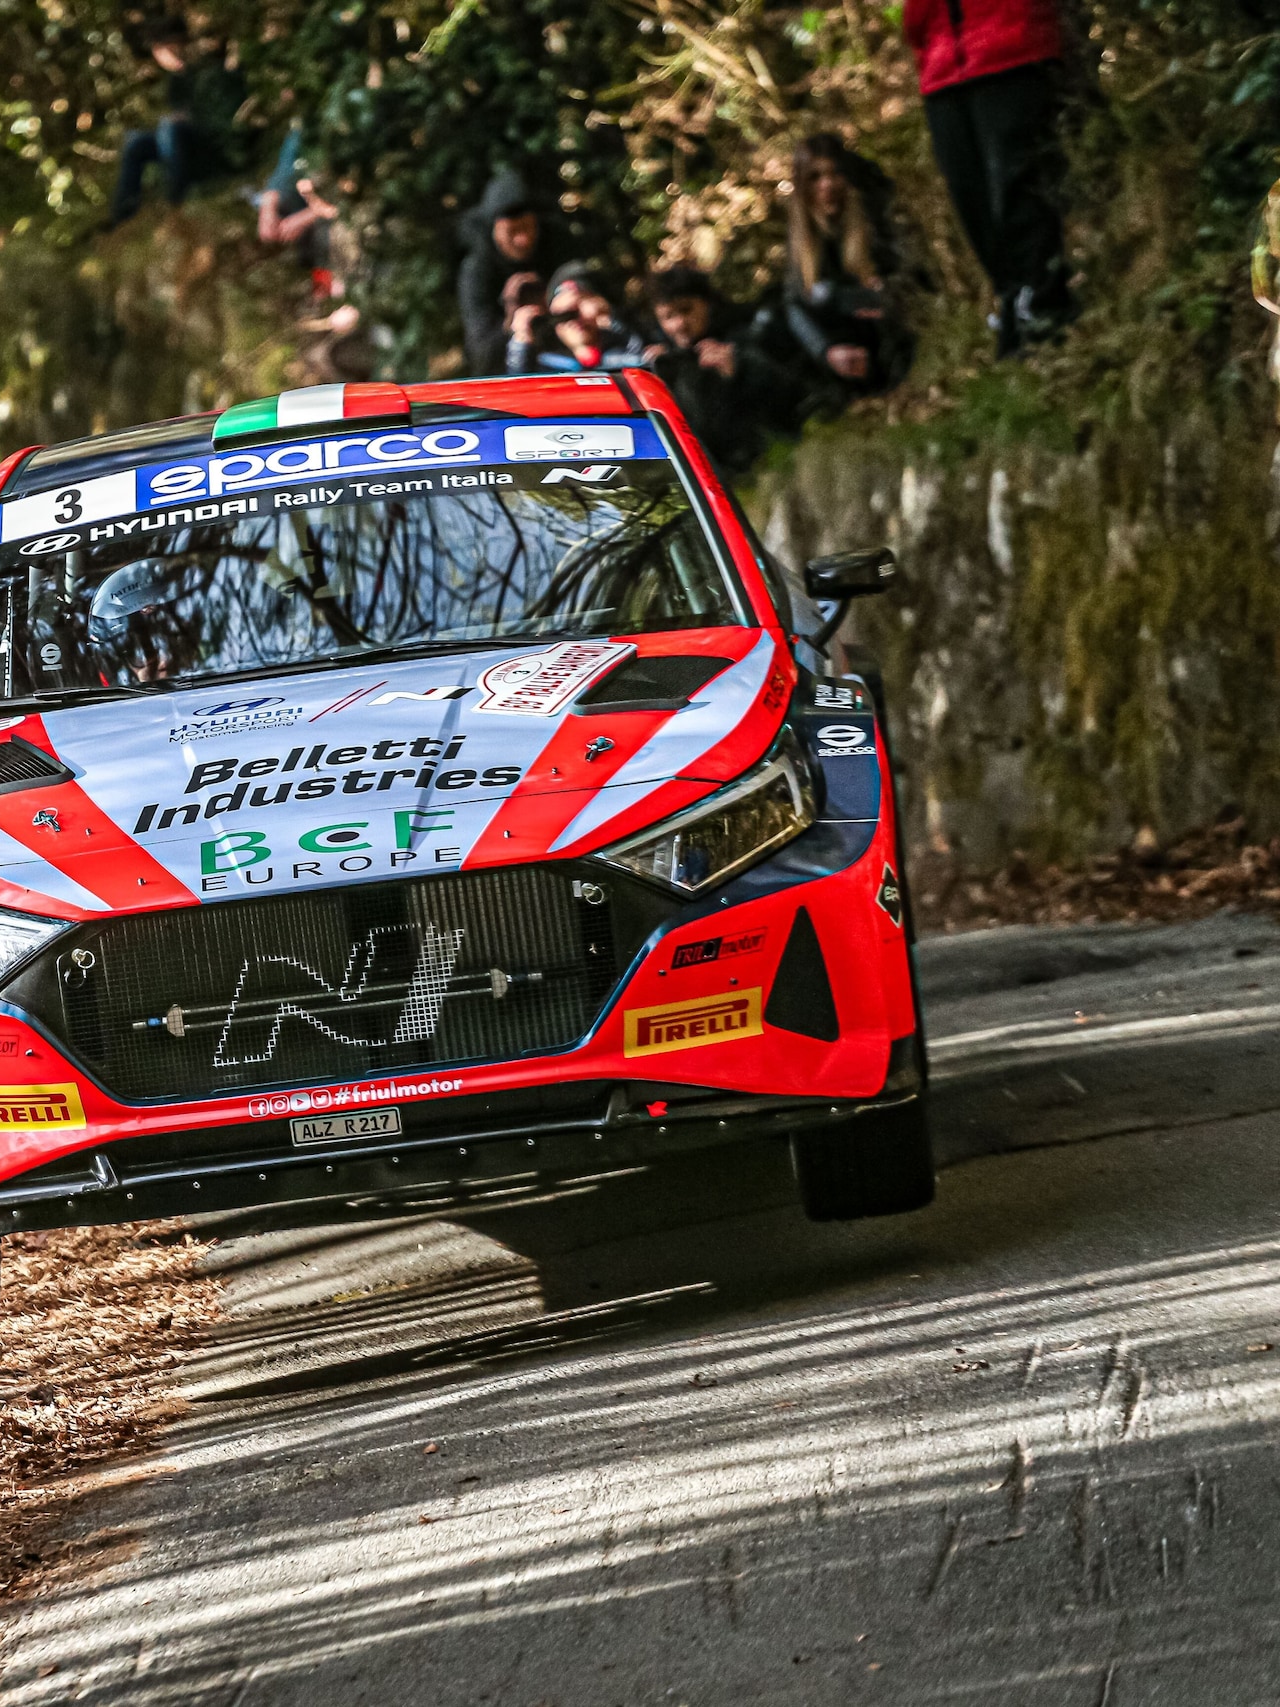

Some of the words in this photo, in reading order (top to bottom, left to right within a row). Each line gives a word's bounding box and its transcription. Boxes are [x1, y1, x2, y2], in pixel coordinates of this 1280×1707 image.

[150, 429, 481, 500] sparco
[515, 448, 625, 460] SPORT
[54, 489, 84, 524] 3
[89, 497, 259, 542] HYUNDAI
[274, 486, 343, 508] Rally
[348, 477, 433, 498] Team
[442, 470, 514, 489] Italia
[513, 670, 570, 698] RALLYE
[169, 714, 302, 743] MOTORSPORT
[170, 707, 303, 736] HYUNDAI
[180, 728, 243, 745] Customer
[248, 721, 294, 732] Racing
[183, 735, 466, 795] Belletti
[132, 761, 522, 835] Industries
[201, 847, 462, 892] EUROPE
[637, 998, 749, 1047] PIRELLI
[334, 1078, 464, 1106] #friulmotor
[302, 1121, 334, 1140] ALZ
